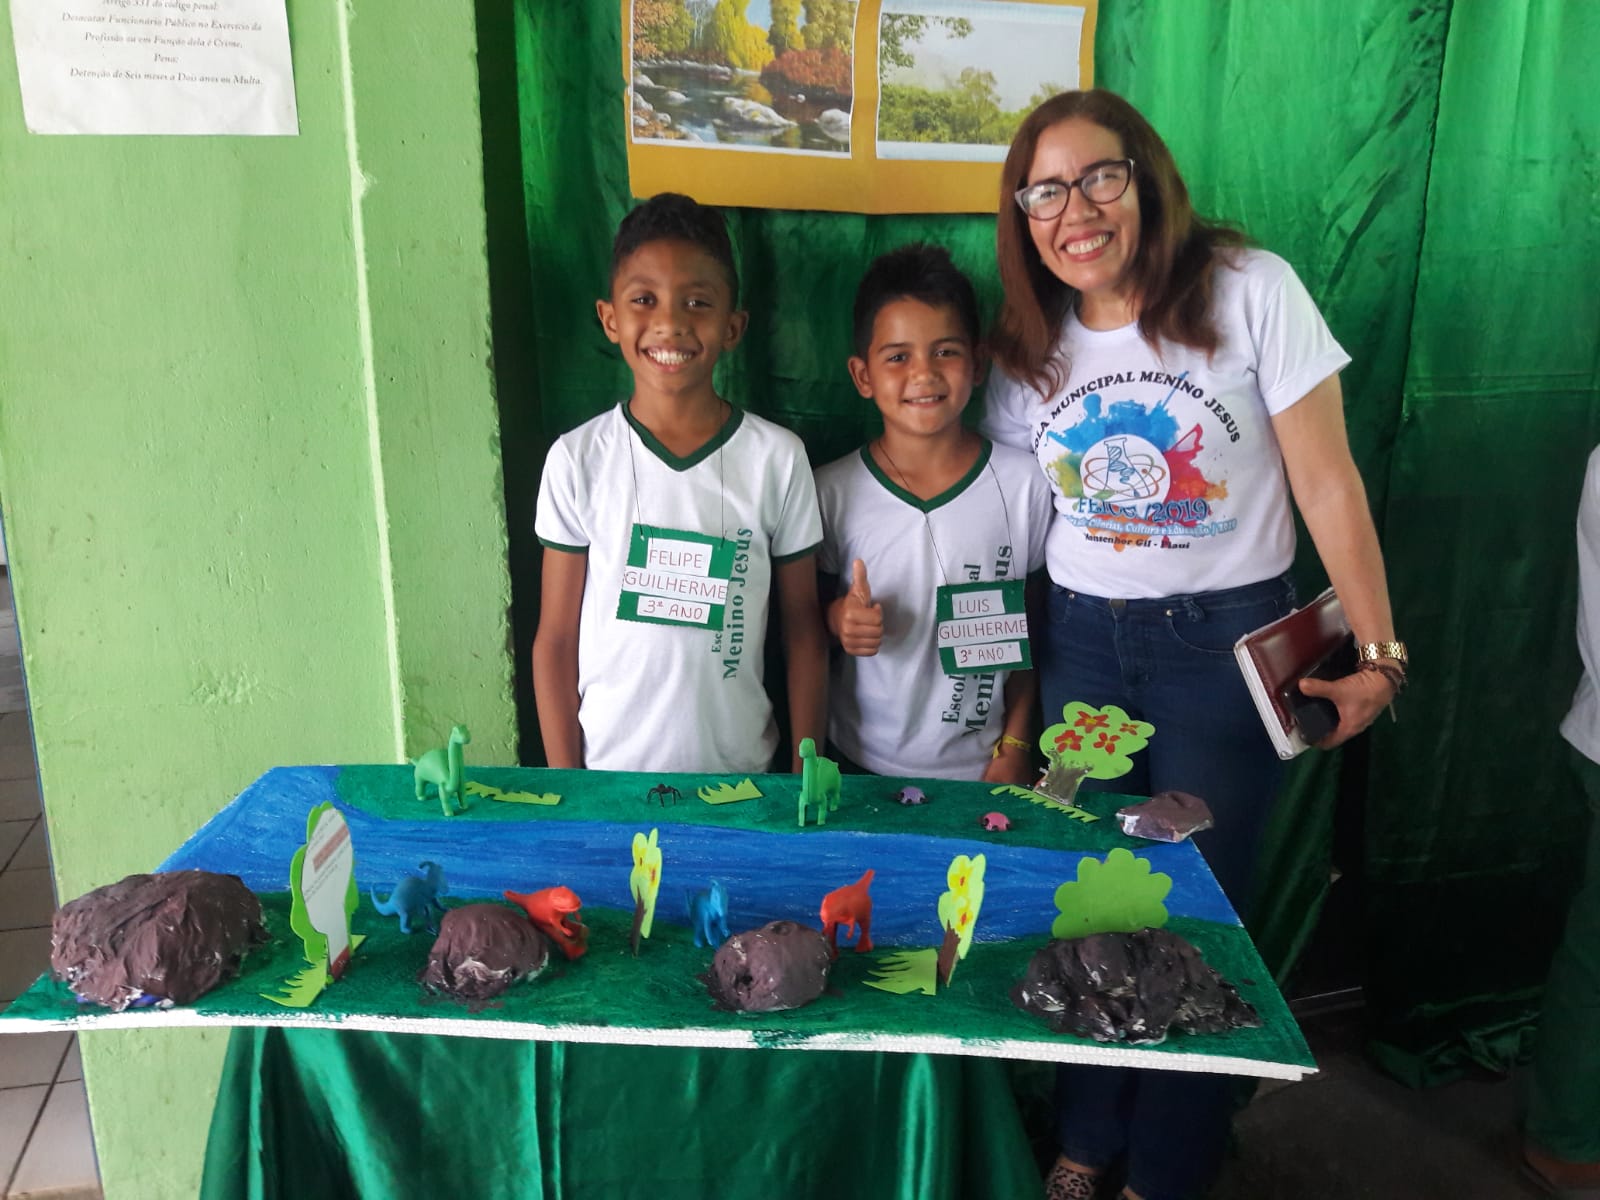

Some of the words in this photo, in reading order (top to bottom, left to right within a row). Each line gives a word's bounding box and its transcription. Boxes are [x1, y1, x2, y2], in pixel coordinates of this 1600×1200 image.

[62, 12, 105, 22] Desacatar
[108, 14, 162, 26] Funcionário
[165, 17, 197, 28] Público
[85, 31, 123, 42] Profissão
[154, 35, 185, 47] Função
[187, 38, 205, 46] dela
[70, 67, 111, 79] Detenção
[113, 70, 123, 78] de
[124, 71, 141, 80] Seis
[178, 72, 197, 81] Dois
[199, 75, 218, 83] anos
[1050, 371, 1136, 420] MUNICIPAL
[1139, 370, 1205, 399] MENINO
[1204, 398, 1242, 443] JESUS
[1125, 522, 1161, 536] Cultura
[1085, 533, 1132, 546] onsenhor
[1135, 538, 1152, 549] Gil
[648, 549, 703, 569] FELIPE
[730, 528, 753, 588] Jesus
[623, 570, 728, 600] GUILHERME
[668, 603, 703, 620] ANO
[958, 599, 990, 614] LUIS
[723, 594, 745, 680] Menino
[938, 619, 1028, 640] GUILHERME
[711, 631, 723, 653] Esc
[978, 646, 1005, 662] ANO
[941, 673, 967, 724] Escol
